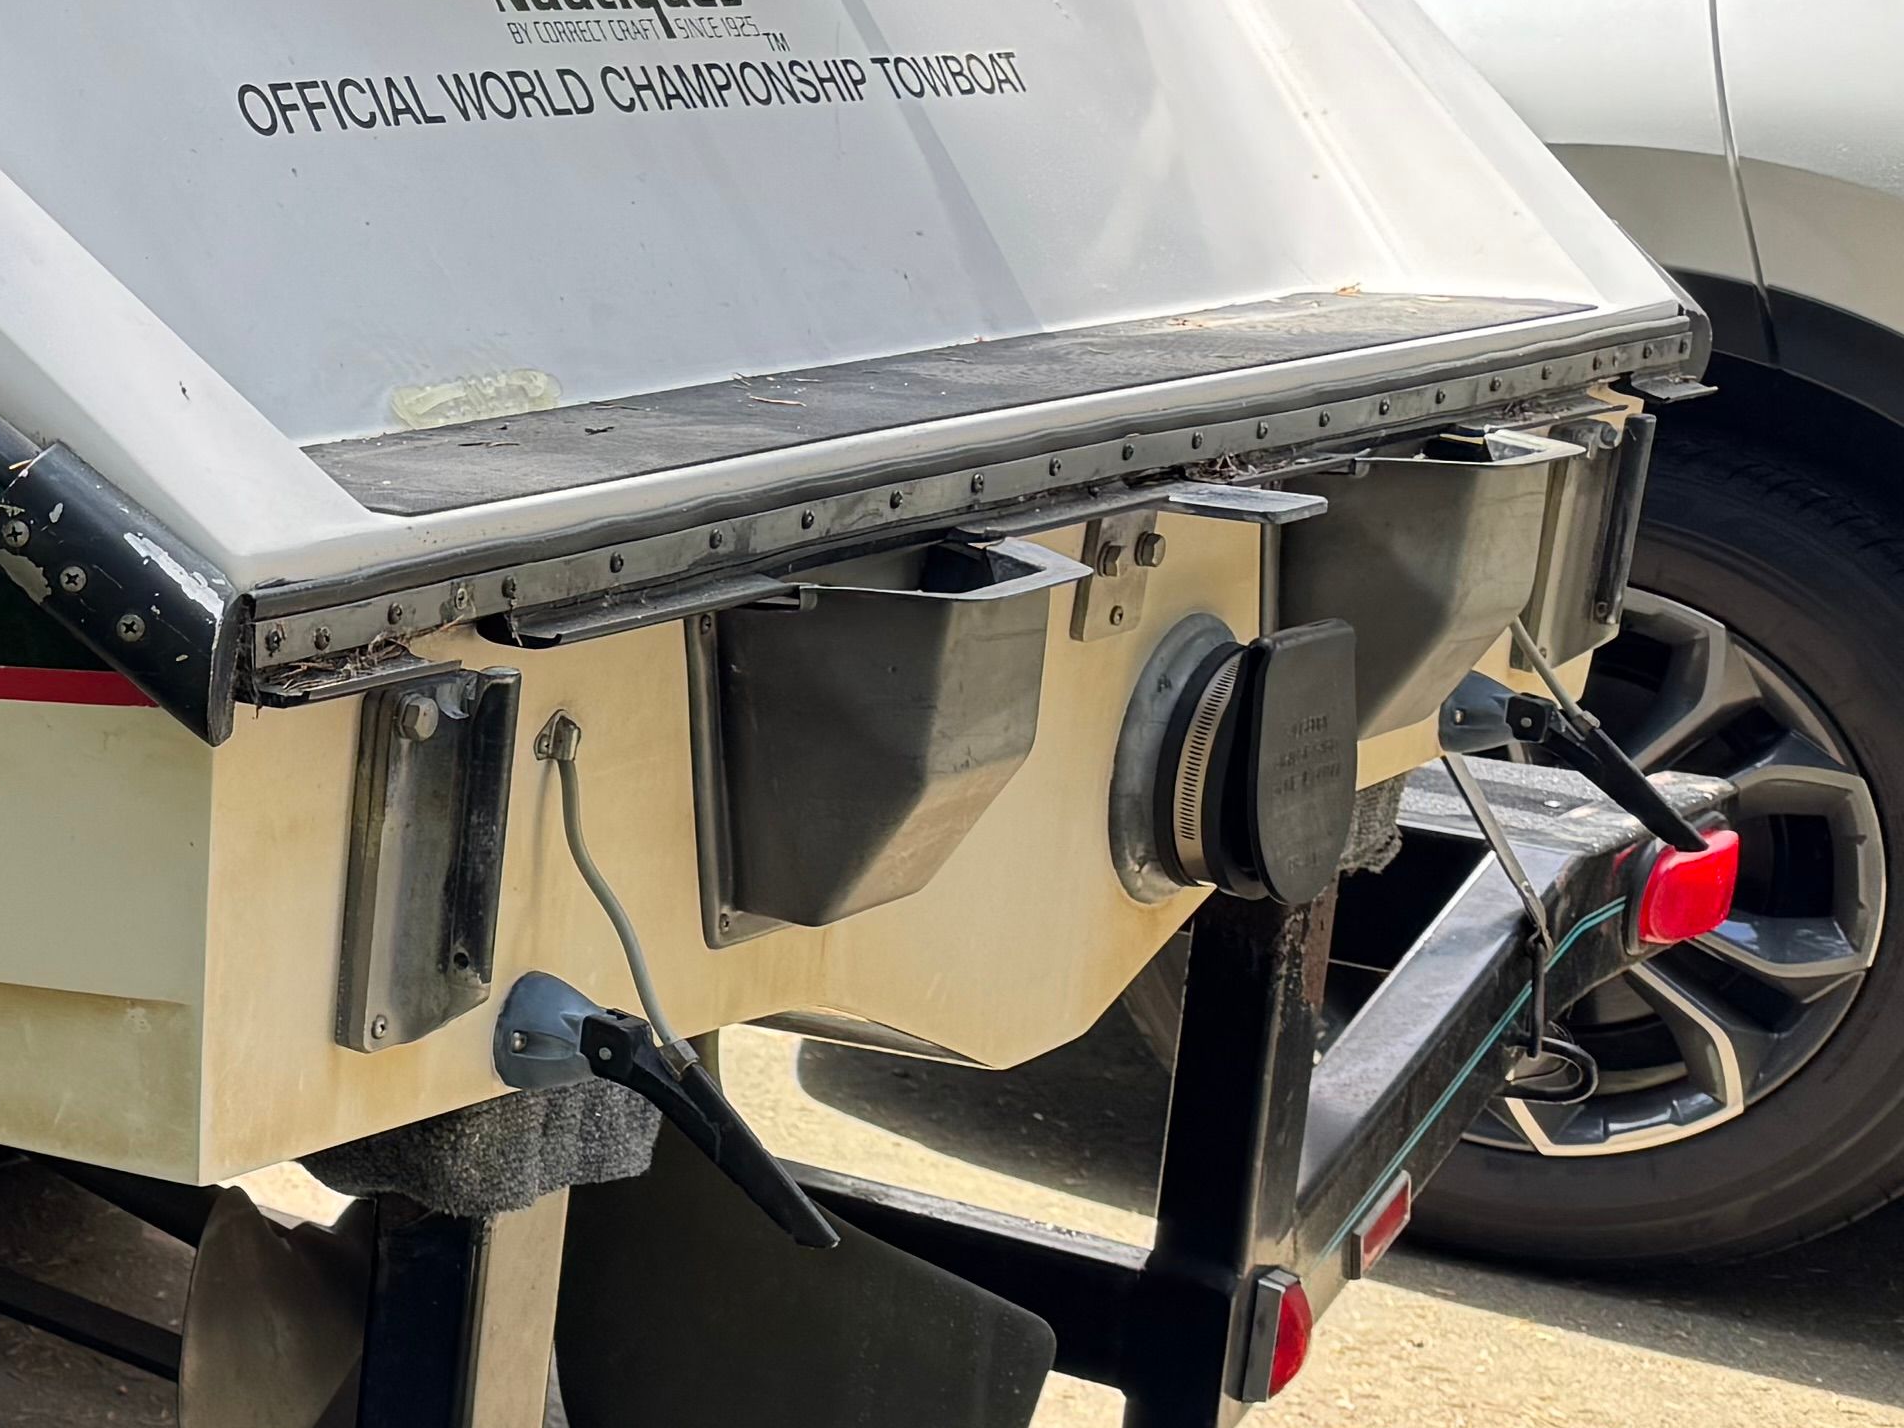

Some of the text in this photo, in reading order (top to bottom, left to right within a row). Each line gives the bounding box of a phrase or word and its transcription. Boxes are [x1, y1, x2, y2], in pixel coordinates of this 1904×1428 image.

[507, 15, 760, 44] BY CORRECT CRAFT SINCE 1925
[763, 33, 790, 52] TM
[237, 51, 1026, 136] OFFICIAL WORLD CHAMPIONSHIP TOWBOAT
